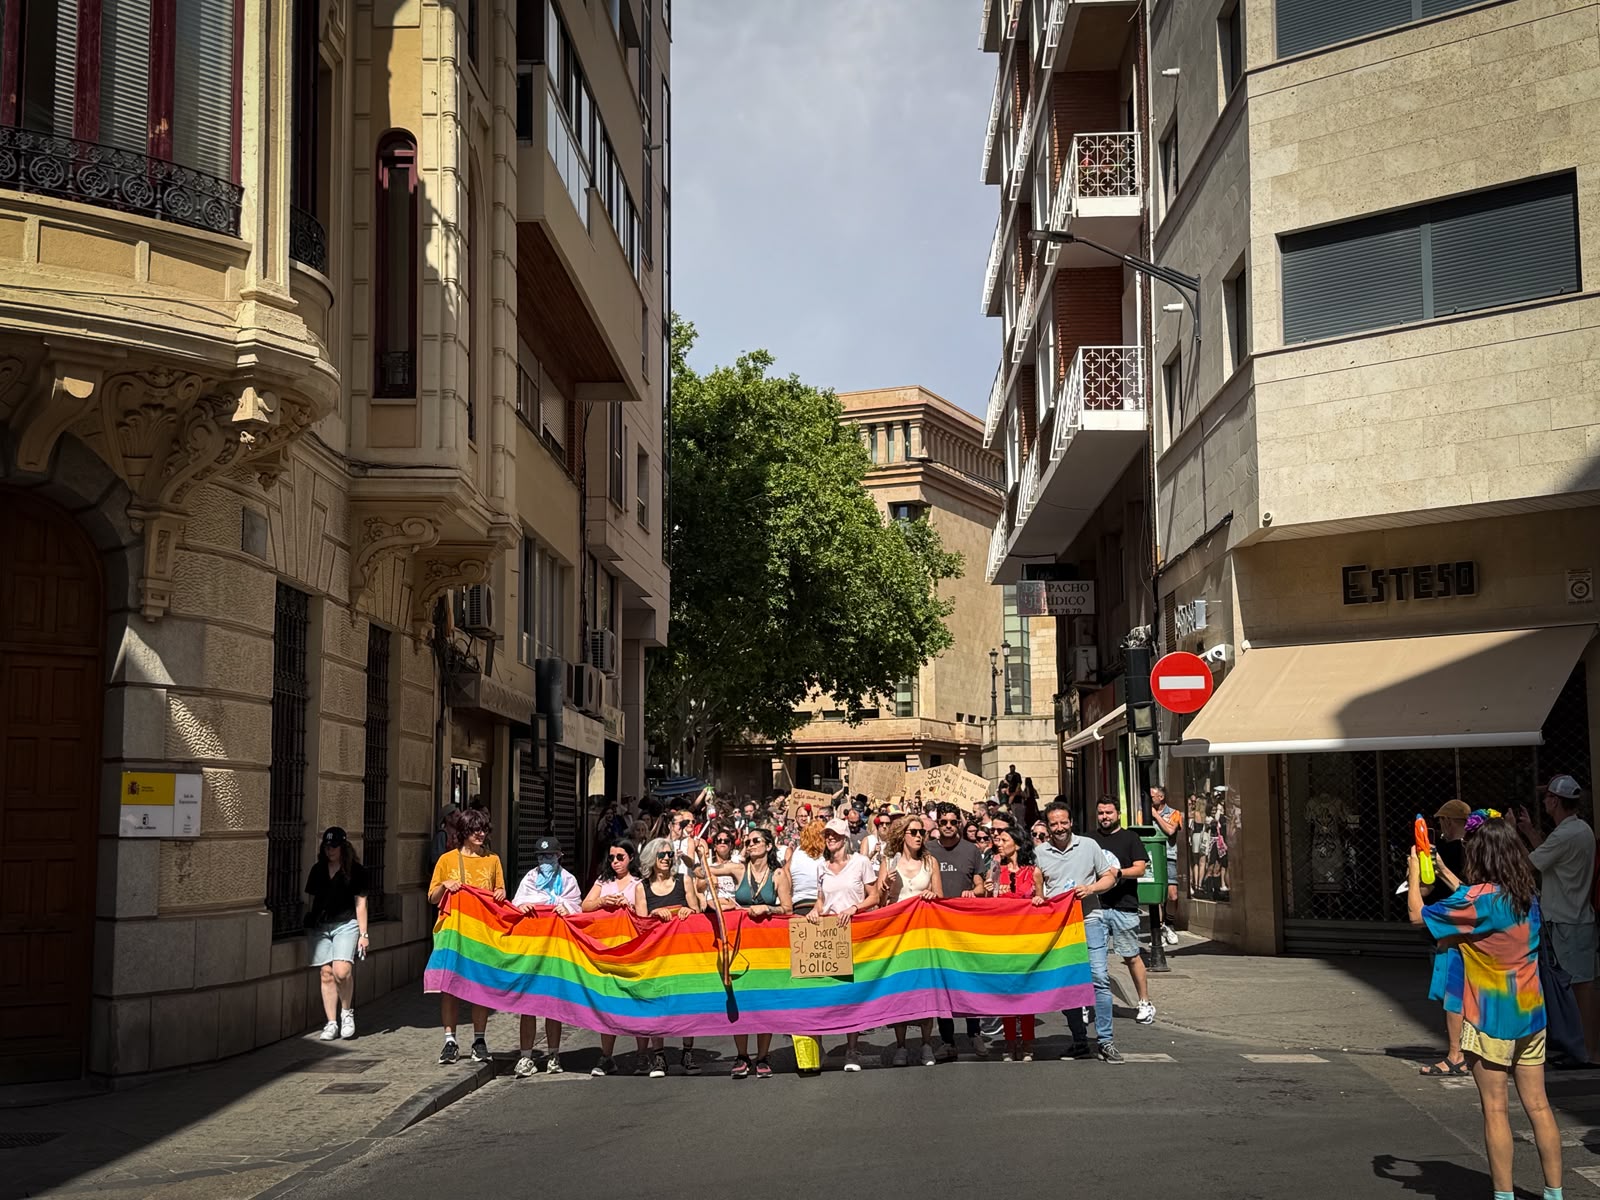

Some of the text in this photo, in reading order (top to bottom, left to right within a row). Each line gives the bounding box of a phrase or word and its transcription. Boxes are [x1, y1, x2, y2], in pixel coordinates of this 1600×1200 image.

[1342, 561, 1475, 606] ESTESO
[798, 927, 838, 941] el horno
[799, 959, 839, 974] bollos
